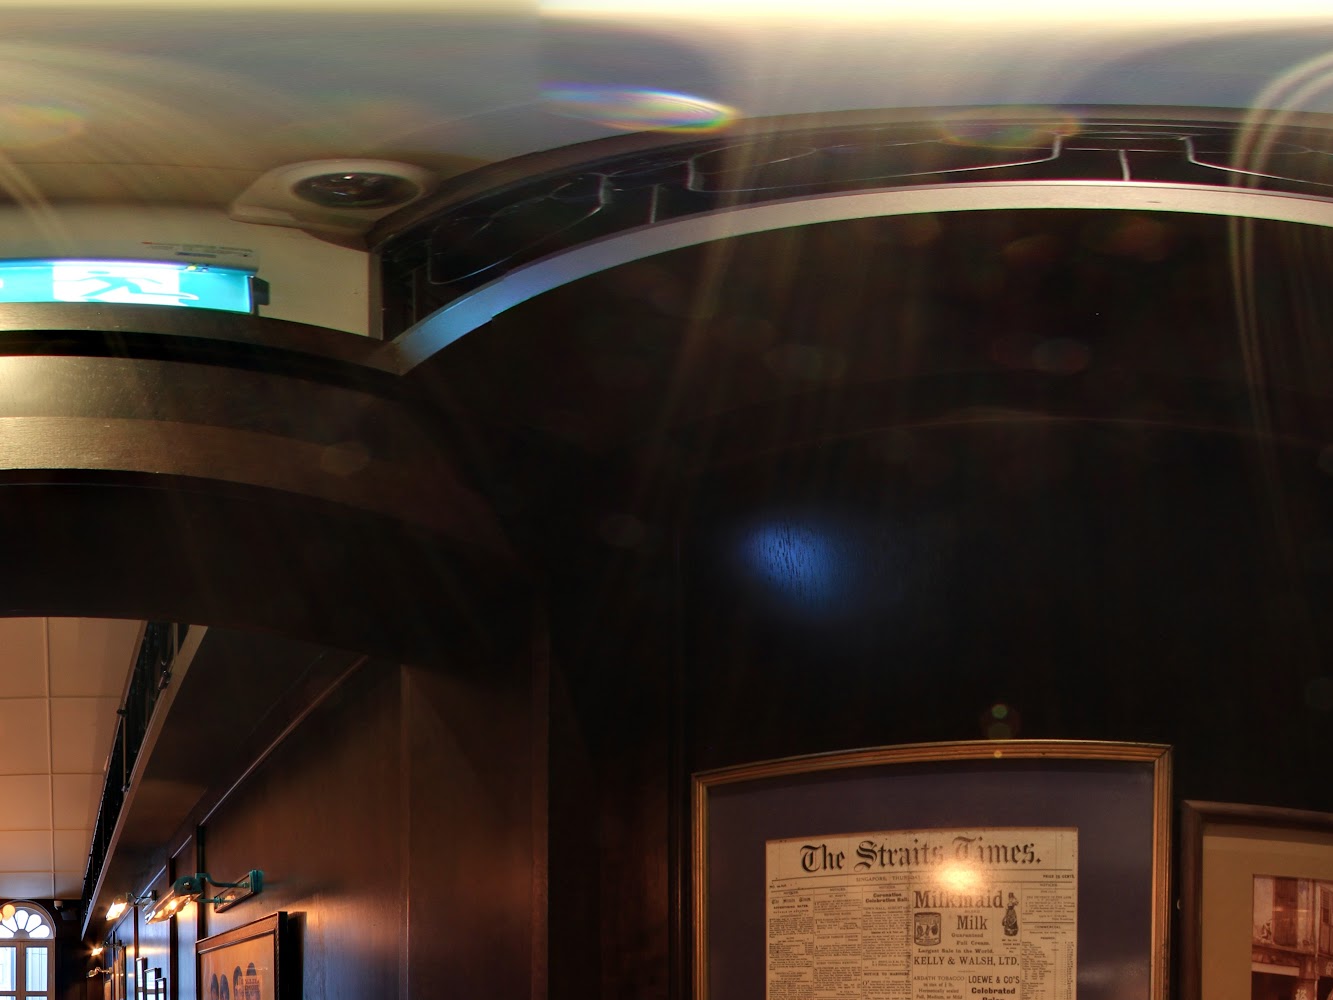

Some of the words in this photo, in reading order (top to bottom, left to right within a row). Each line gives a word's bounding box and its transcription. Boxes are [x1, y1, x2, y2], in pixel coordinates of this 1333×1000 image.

[800, 842, 846, 873] The
[854, 836, 943, 872] Straits
[951, 834, 1041, 868] Times.
[857, 875, 888, 883] SINGAPORE,
[913, 889, 1004, 909] Milkmaid
[956, 914, 988, 931] Milk
[914, 956, 944, 966] KELLY
[948, 956, 956, 966] &
[960, 956, 996, 966] WALSH,
[998, 956, 1020, 966] LTD.
[968, 976, 993, 984] LOEWE
[996, 976, 1001, 984] &
